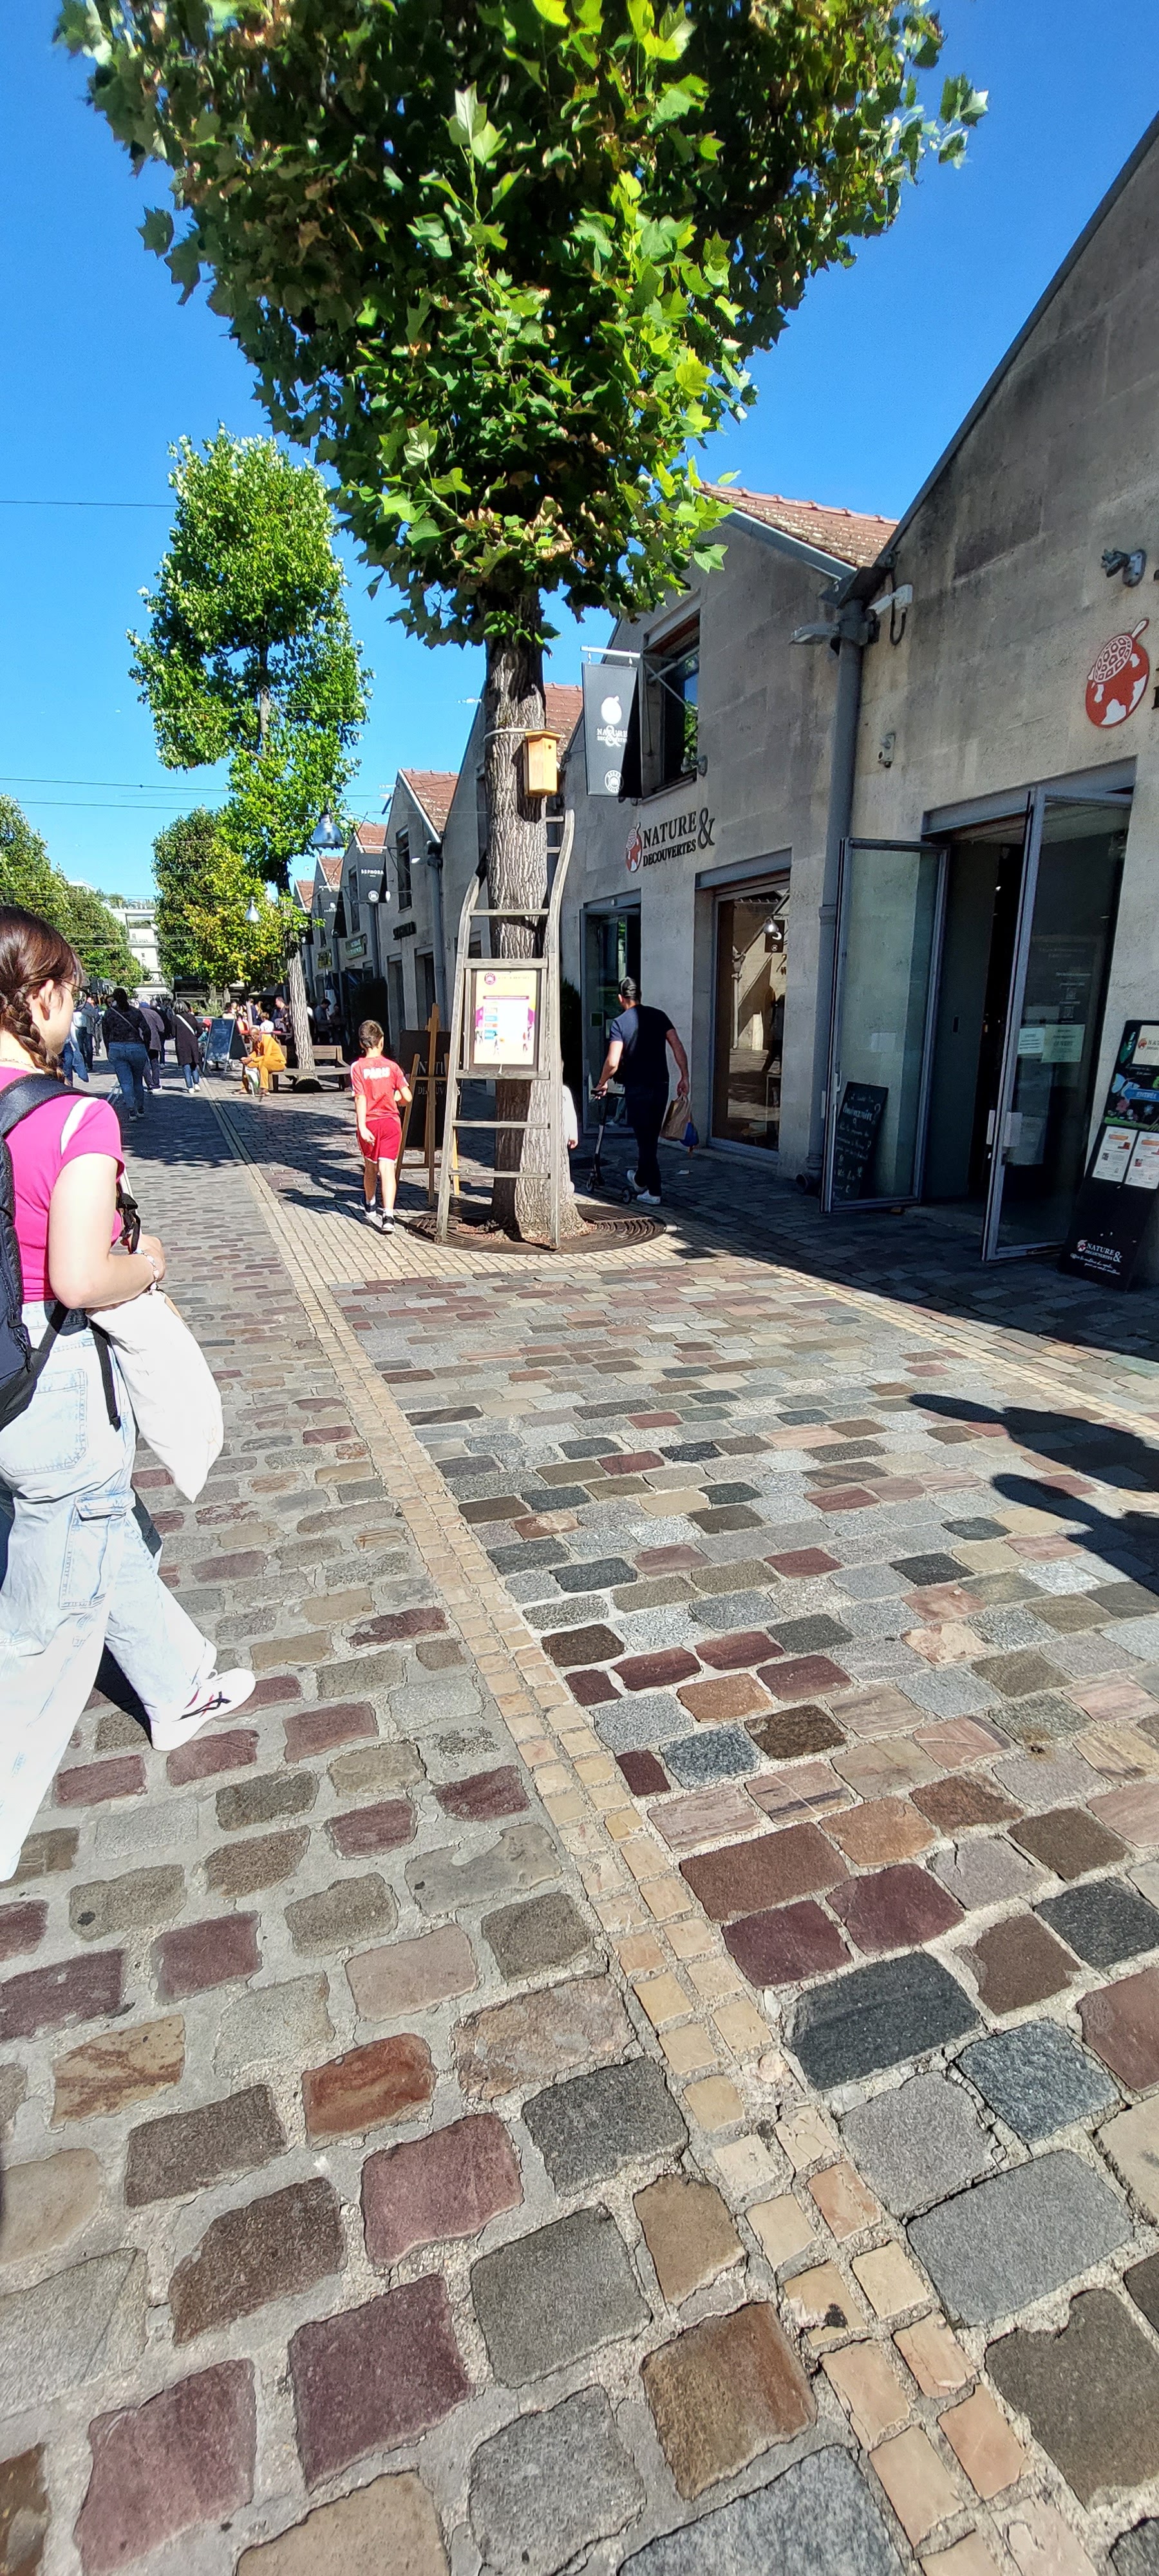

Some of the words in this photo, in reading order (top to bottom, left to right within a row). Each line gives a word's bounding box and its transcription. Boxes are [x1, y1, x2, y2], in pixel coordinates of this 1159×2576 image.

[643, 811, 697, 849] NATURE
[698, 807, 715, 849] &
[643, 839, 697, 867] DECOUVERTES
[1086, 1242, 1116, 1256] NATURE
[1113, 1251, 1124, 1263] &
